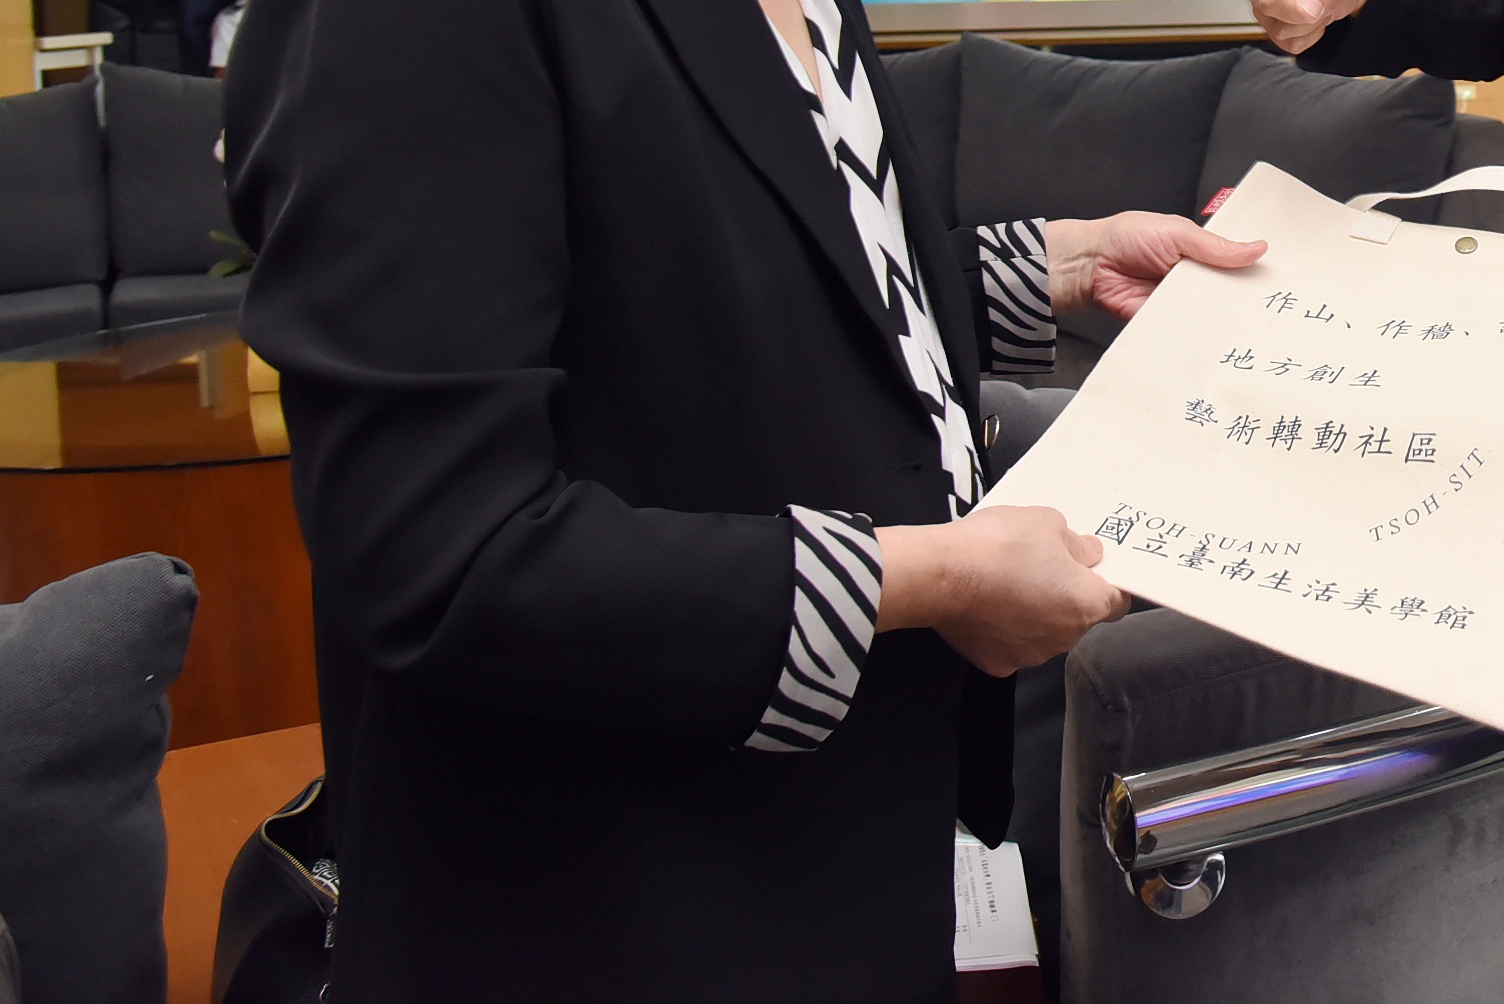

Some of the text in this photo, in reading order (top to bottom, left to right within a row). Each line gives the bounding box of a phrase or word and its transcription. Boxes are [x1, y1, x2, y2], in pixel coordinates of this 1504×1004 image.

[1219, 348, 1382, 387] 地方創生
[1184, 398, 1437, 464] 藝術轉動社區
[1369, 448, 1486, 542] TSOH-SIT
[1111, 502, 1303, 556] TSOH-SUANN
[1094, 515, 1476, 631] 國立臺南生活美學館
